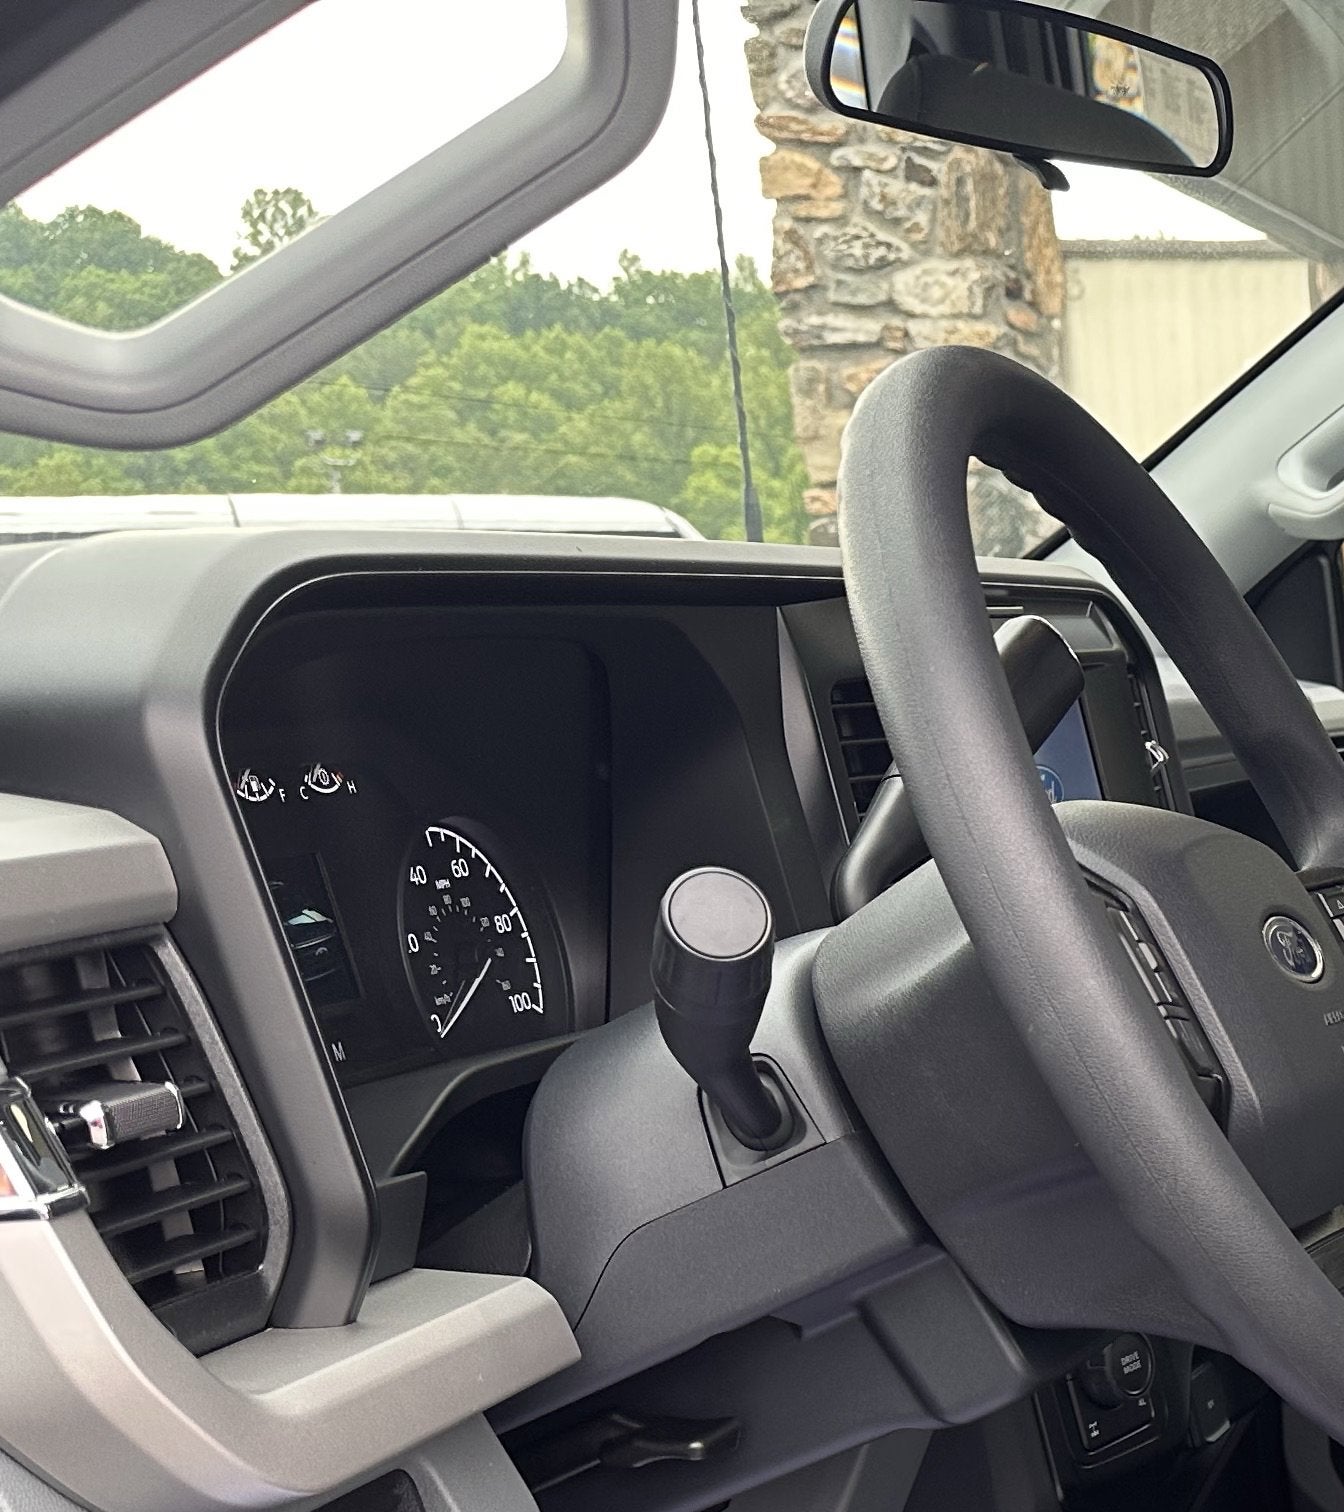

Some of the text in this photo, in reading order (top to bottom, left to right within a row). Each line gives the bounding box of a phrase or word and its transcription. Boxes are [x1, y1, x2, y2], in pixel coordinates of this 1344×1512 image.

[279, 789, 286, 802] F
[300, 786, 309, 799] C
[347, 780, 357, 793] H
[410, 865, 427, 885] 40
[451, 859, 469, 877] 60
[494, 914, 512, 933] 80
[408, 933, 419, 953] 0
[509, 992, 531, 1013] 100
